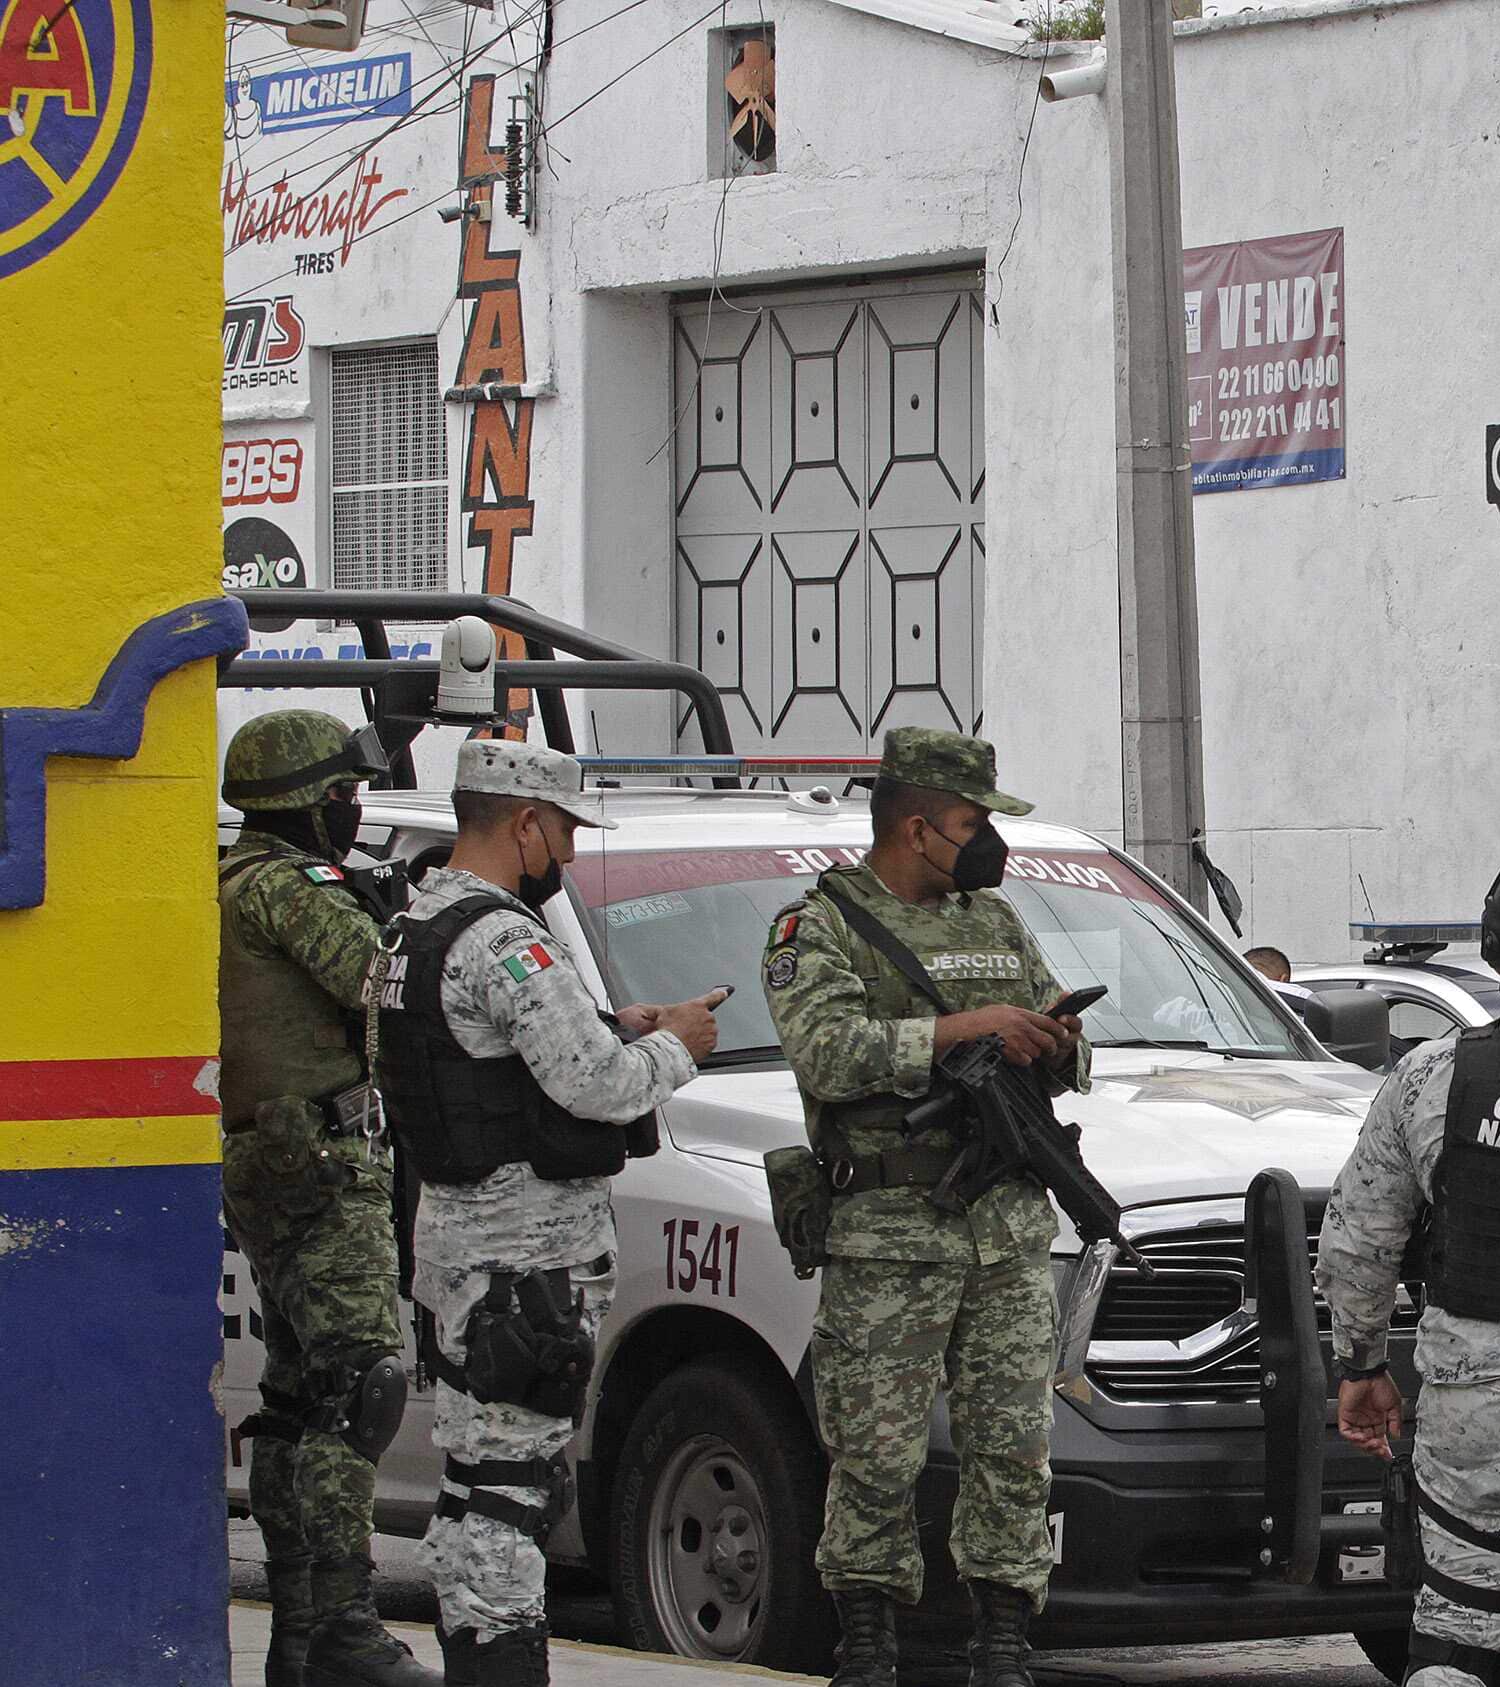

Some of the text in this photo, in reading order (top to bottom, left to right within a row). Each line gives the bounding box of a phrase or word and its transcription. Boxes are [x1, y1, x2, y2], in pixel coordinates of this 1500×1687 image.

[267, 61, 403, 115] MICHELIN
[295, 252, 335, 276] TIRES
[1218, 272, 1339, 350] VENDE
[222, 441, 302, 503] BBS
[1192, 464, 1315, 486] abitatinmobiliarias.com.mx
[222, 554, 298, 588] saxo
[924, 953, 1020, 971] JÉRCITO
[928, 969, 1018, 979] EXICANO
[663, 1217, 739, 1298] 1541
